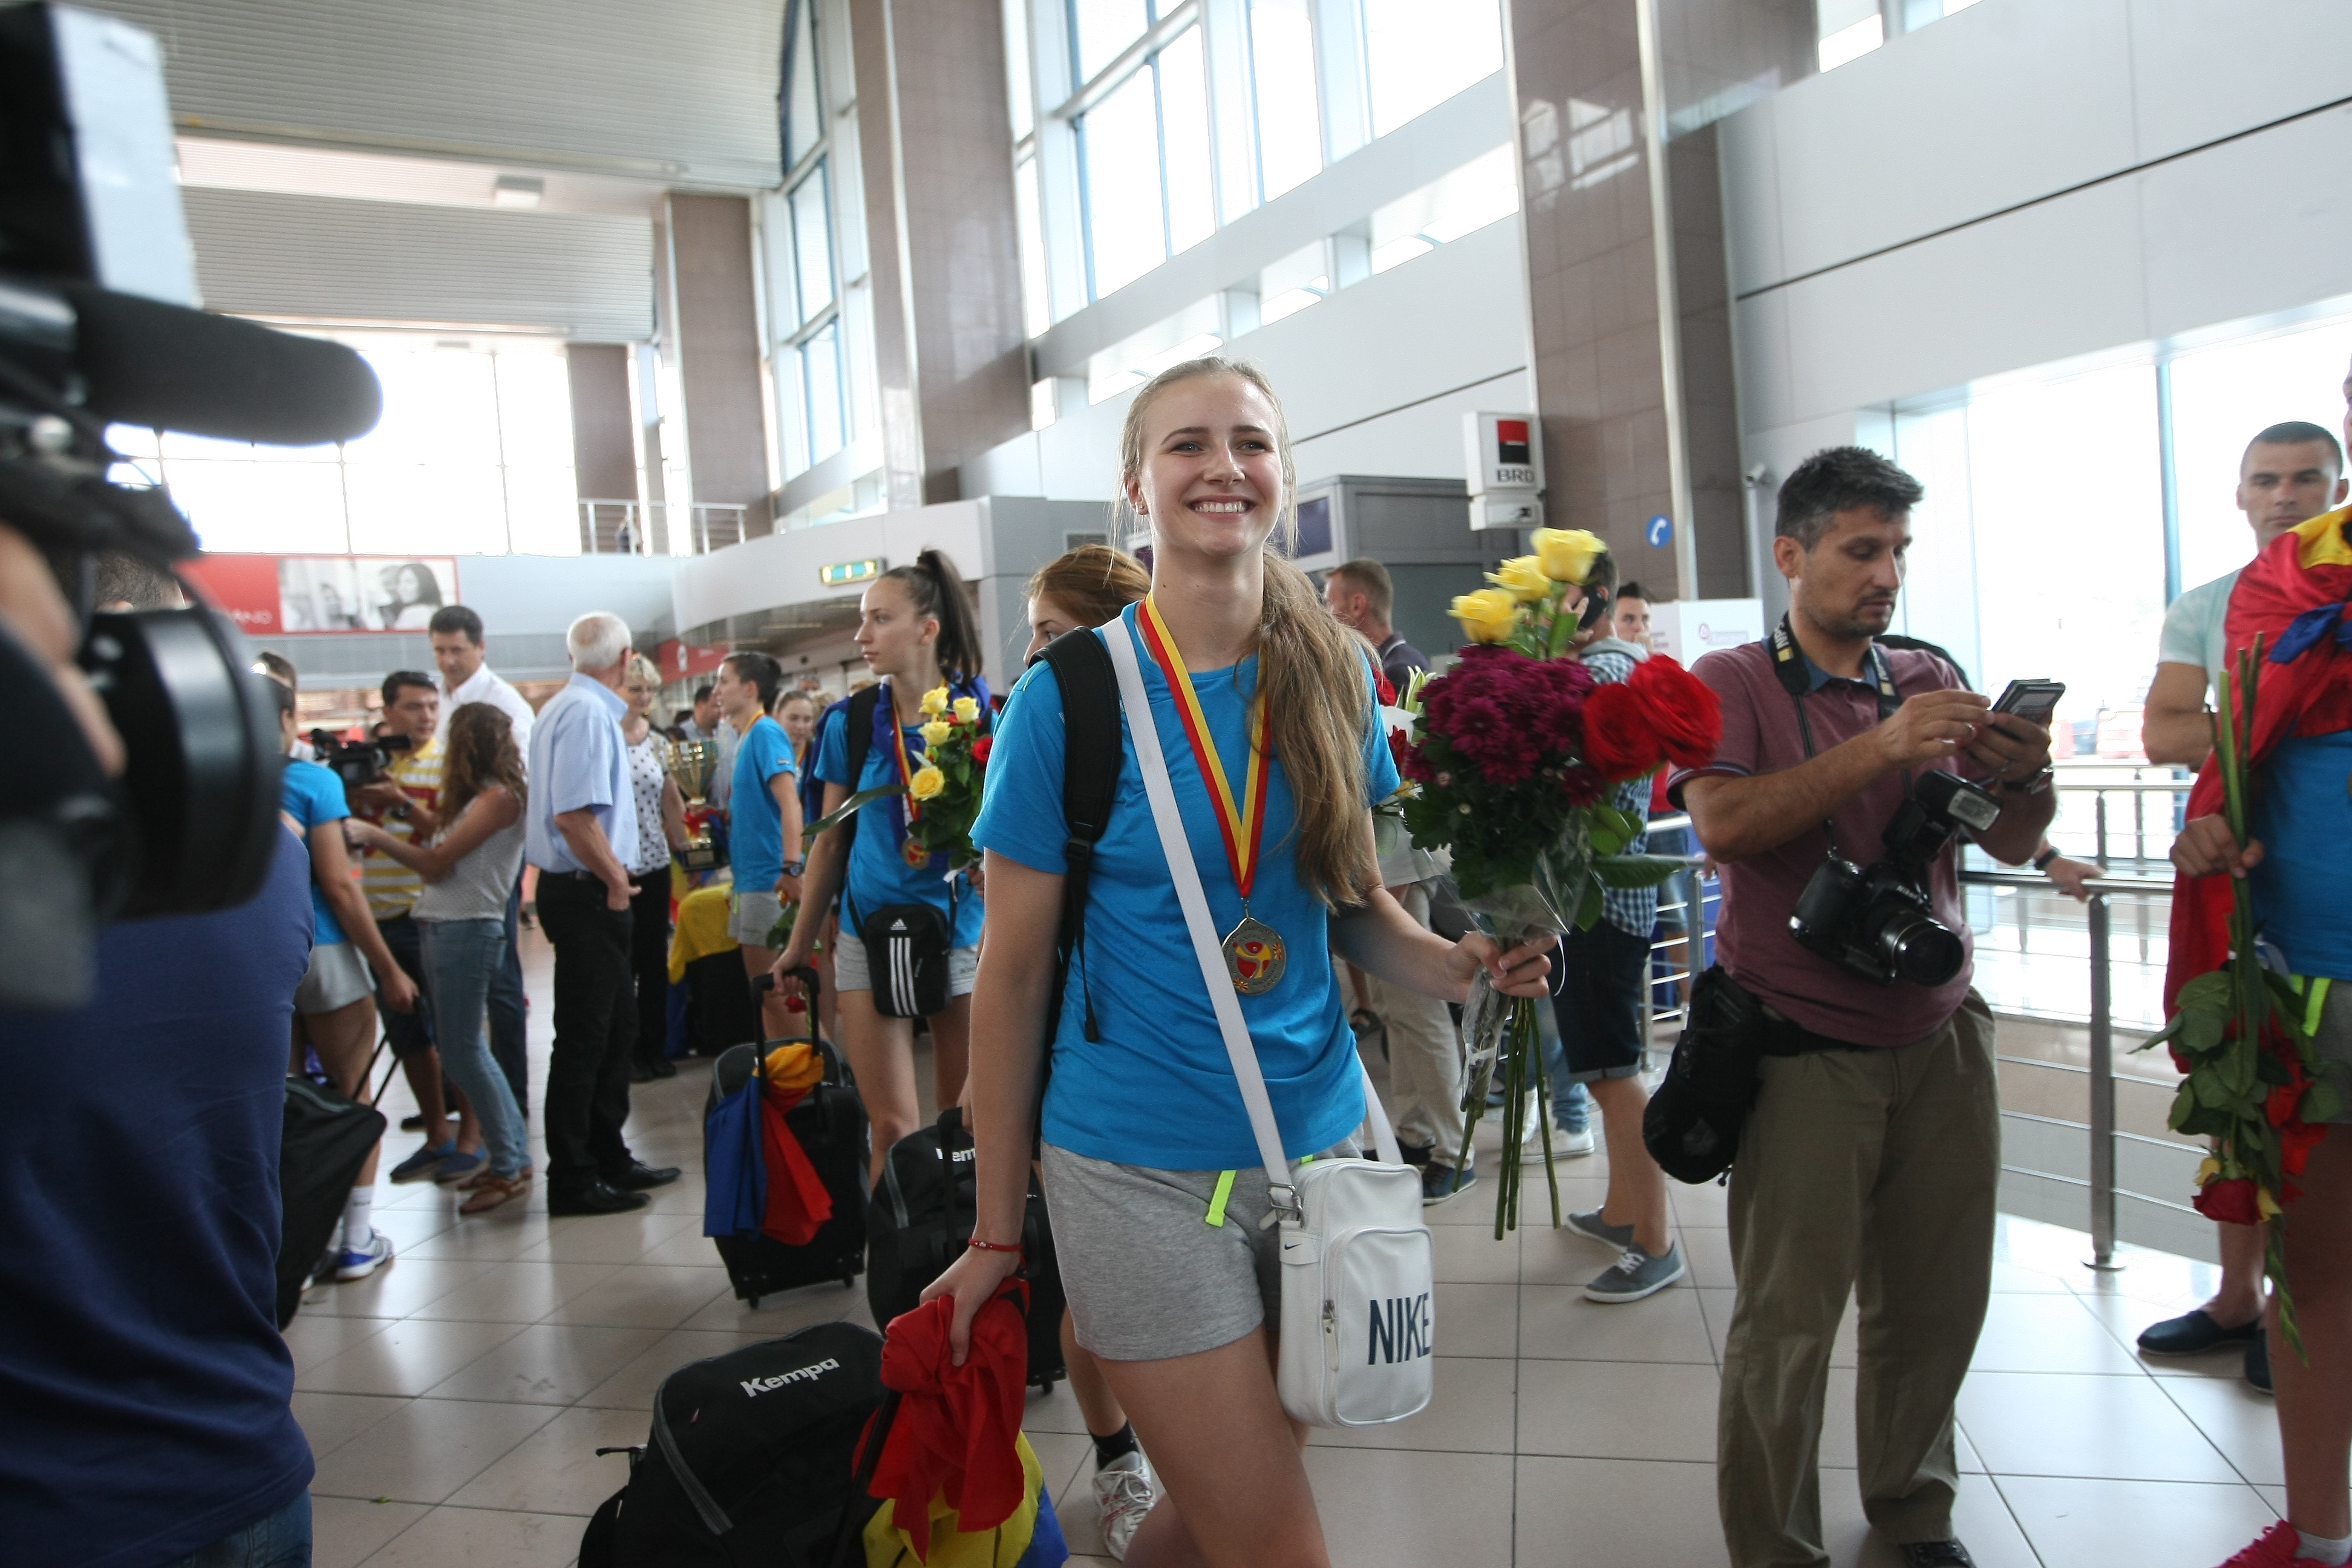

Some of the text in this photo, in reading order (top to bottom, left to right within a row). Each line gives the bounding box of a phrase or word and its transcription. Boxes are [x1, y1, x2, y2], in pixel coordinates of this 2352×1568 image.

[1497, 468, 1534, 482] BRD
[1368, 1292, 1431, 1365] NIKE
[739, 1357, 840, 1397] Kempa
